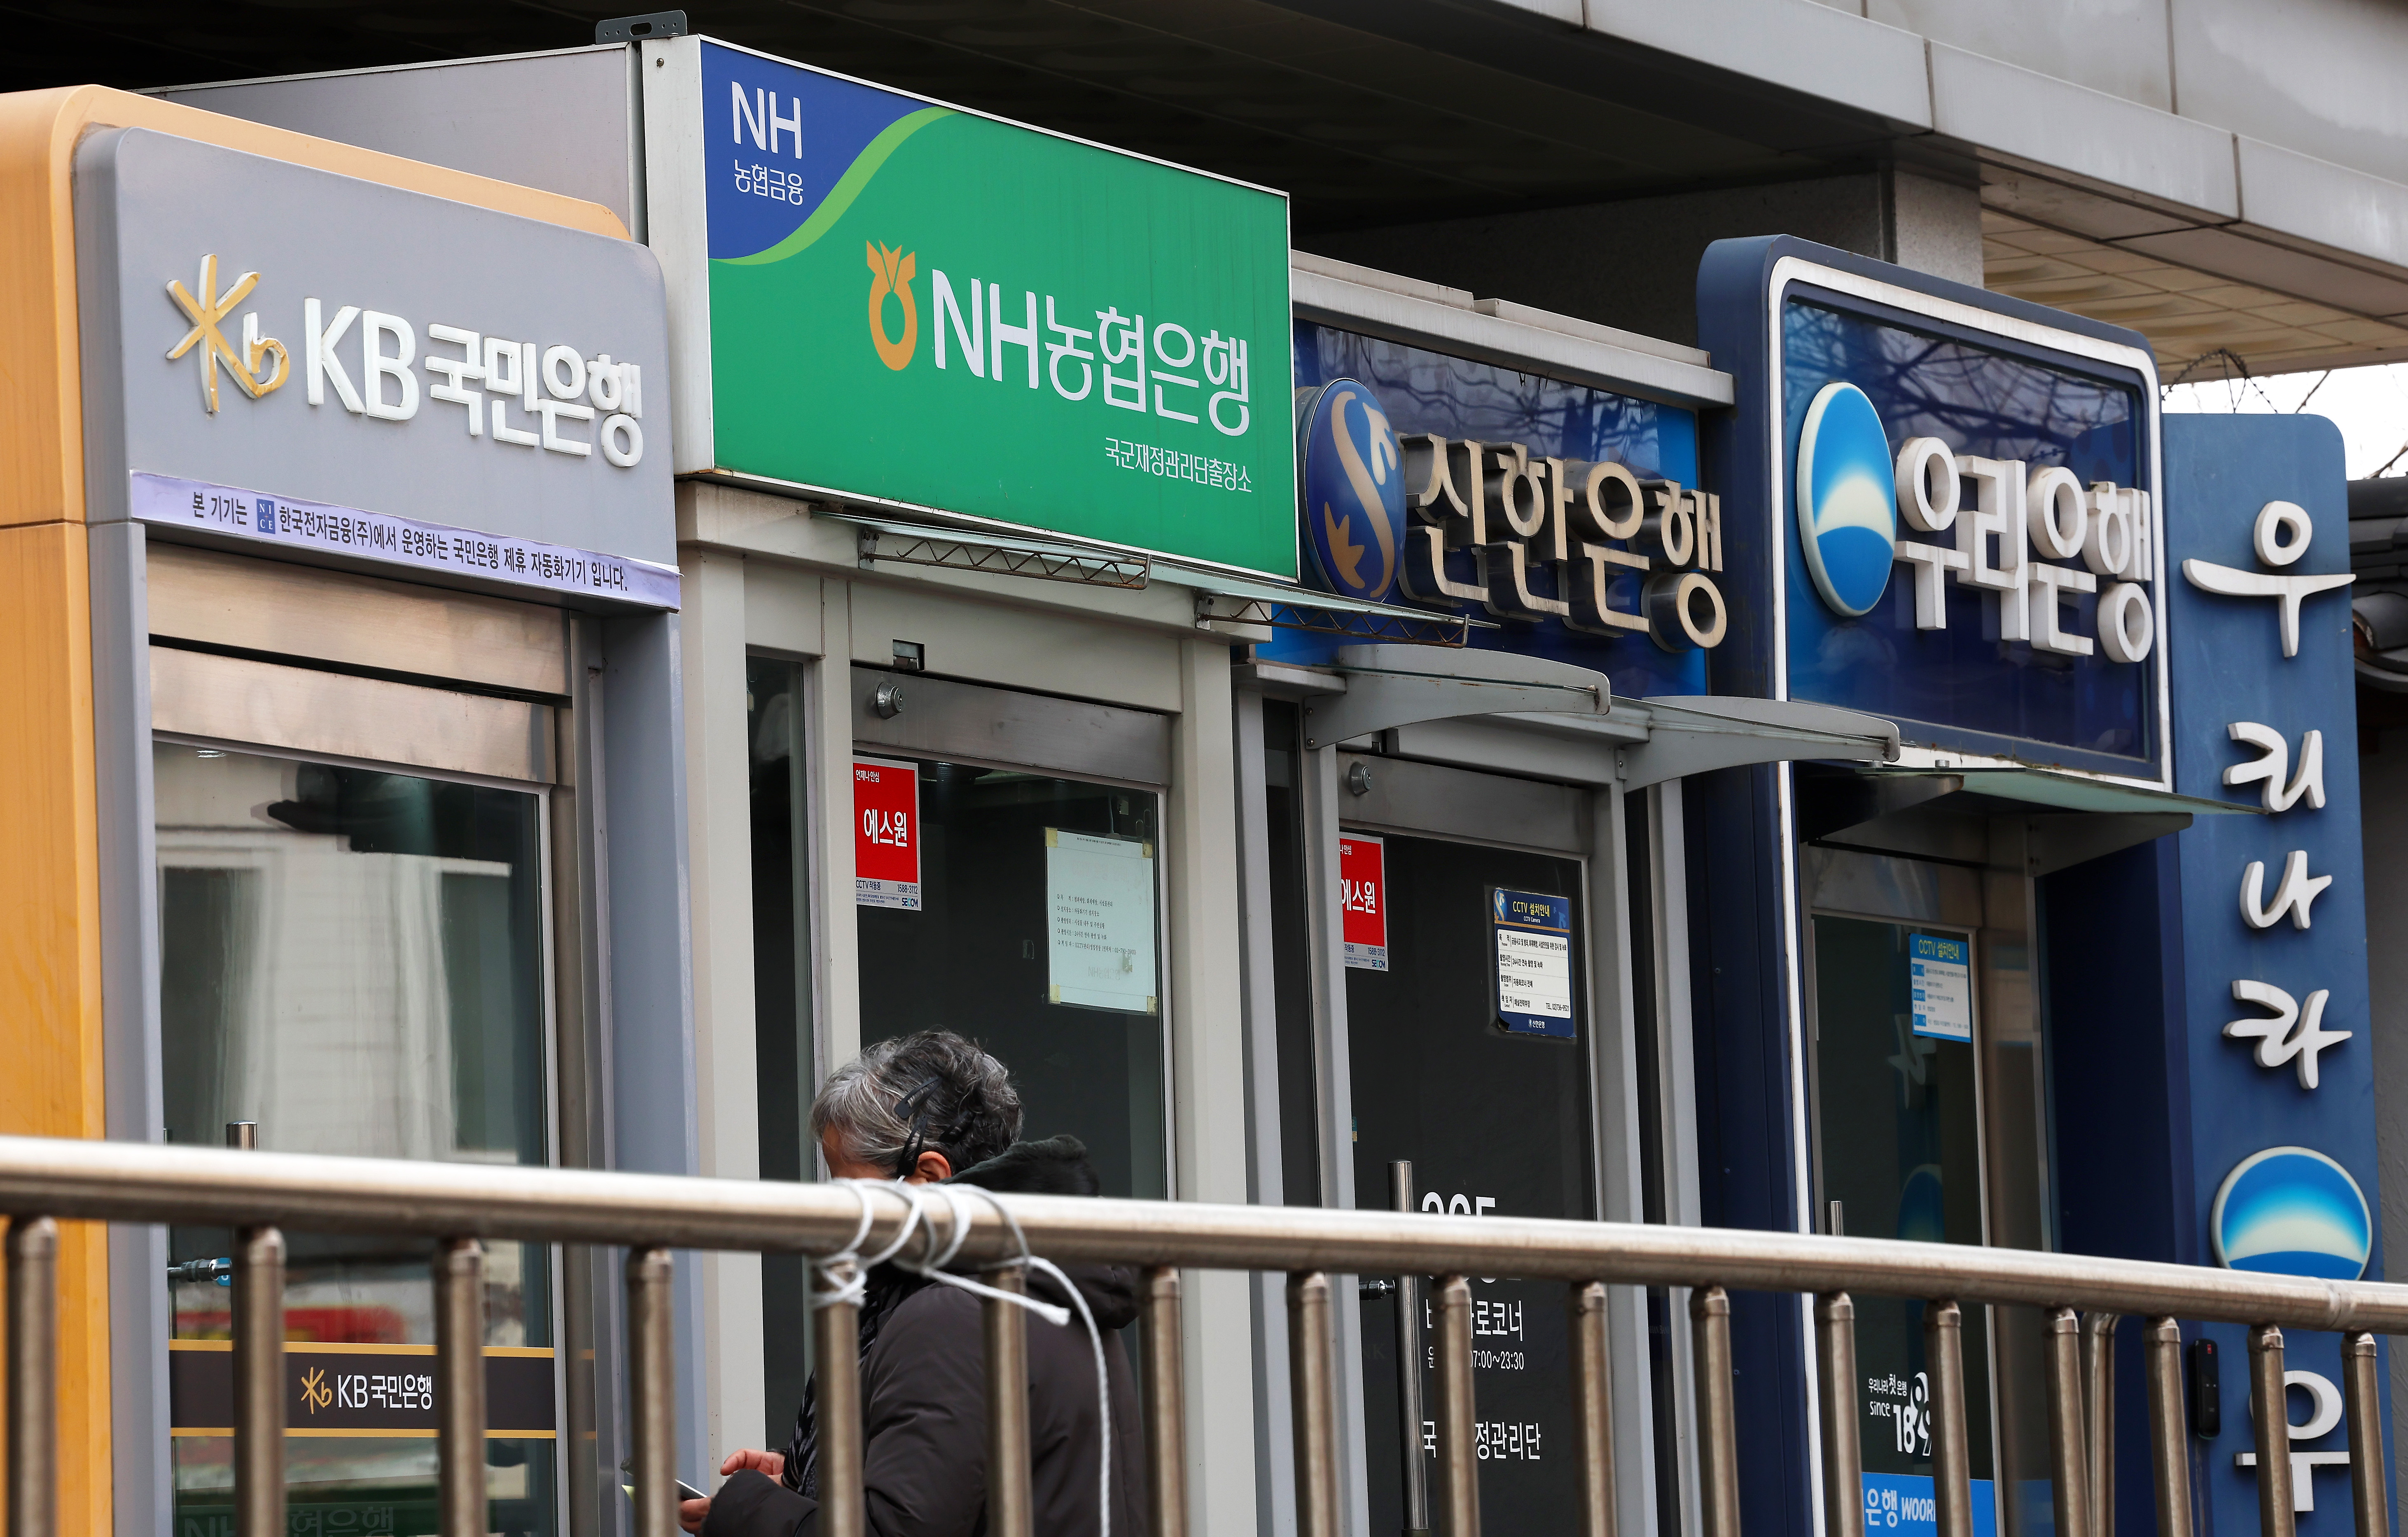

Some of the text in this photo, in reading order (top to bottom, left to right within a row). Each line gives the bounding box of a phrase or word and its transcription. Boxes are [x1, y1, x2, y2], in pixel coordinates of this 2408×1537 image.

[731, 81, 802, 159] NH
[734, 159, 803, 206] 농협금융
[932, 268, 1250, 436] NH농협은행
[305, 297, 644, 467] KB국민은행
[1105, 437, 1252, 492] 국군재정관리단출장소
[193, 492, 205, 518] 본
[211, 495, 247, 526] 기기는
[279, 506, 397, 552] 한국전자금융(주)에서
[402, 528, 448, 560] 운영하는
[453, 537, 499, 569] 국민은행
[504, 547, 526, 574] 제휴
[531, 551, 586, 585] 자동화기기
[591, 561, 628, 591] 입니다.
[1400, 433, 1727, 652] 신한은행
[1895, 436, 2154, 662] 우리은행
[856, 770, 880, 782] 언제나 안심
[2182, 500, 2357, 1089] 우리나라
[864, 809, 907, 847] 에스원
[1344, 844, 1352, 855] 안심
[897, 884, 918, 894] 1588-3112
[902, 897, 918, 907] SECOM
[1341, 879, 1376, 914] 에스원
[1513, 901, 1550, 917] CCTV 설치안내
[1368, 947, 1385, 956] 1588-3112
[1500, 954, 1511, 962] 촬영시간
[1919, 939, 1936, 955] CCTV
[1372, 959, 1385, 968] SECOM
[1501, 975, 1511, 983] 촬영범위
[1513, 978, 1527, 987] 자동화코너
[1532, 1020, 1545, 1029] 신한은행
[1470, 1350, 1524, 1370] 7:00~23:30
[337, 1374, 432, 1411] KB국민은행
[1868, 1374, 1907, 1397] 우리나라 첫 은행
[1423, 1421, 1541, 1460] 국정관리단
